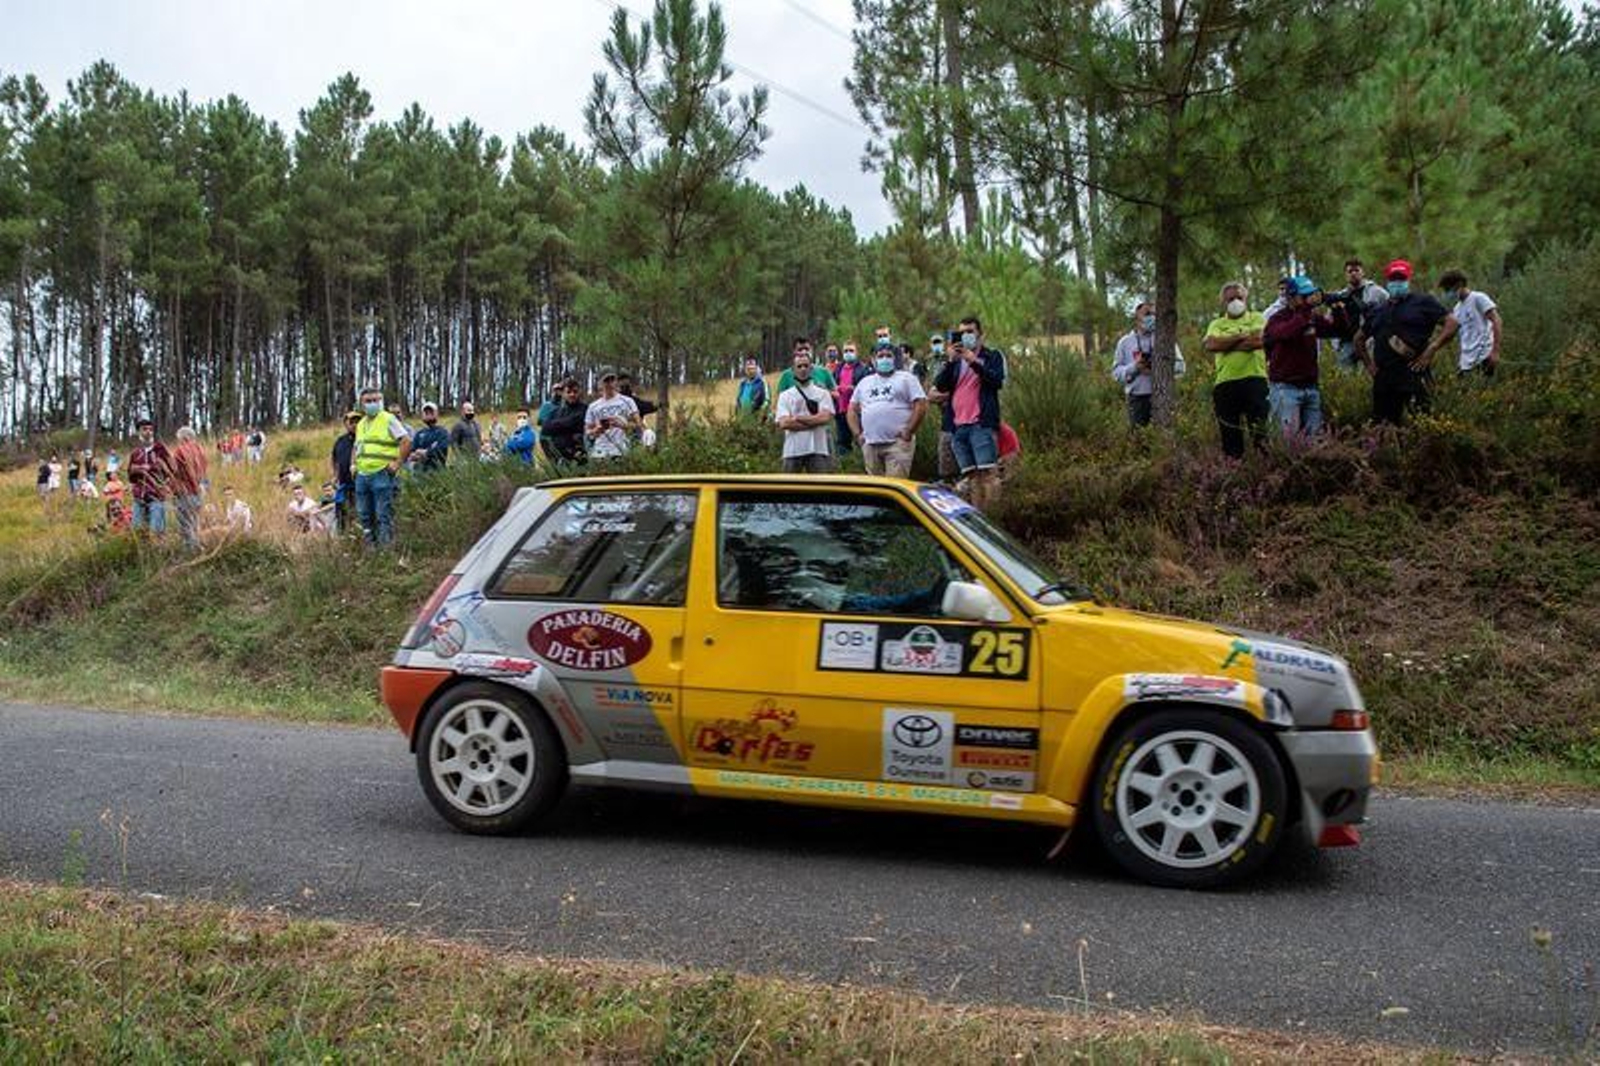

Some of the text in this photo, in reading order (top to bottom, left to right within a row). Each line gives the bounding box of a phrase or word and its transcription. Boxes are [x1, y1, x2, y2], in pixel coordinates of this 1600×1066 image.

[542, 611, 641, 642] PANADERIA
[547, 641, 626, 668] DELFIN
[968, 630, 1025, 676] 25
[633, 689, 673, 703] NOVA
[891, 750, 944, 767] Toyota
[888, 765, 945, 780] Ourense
